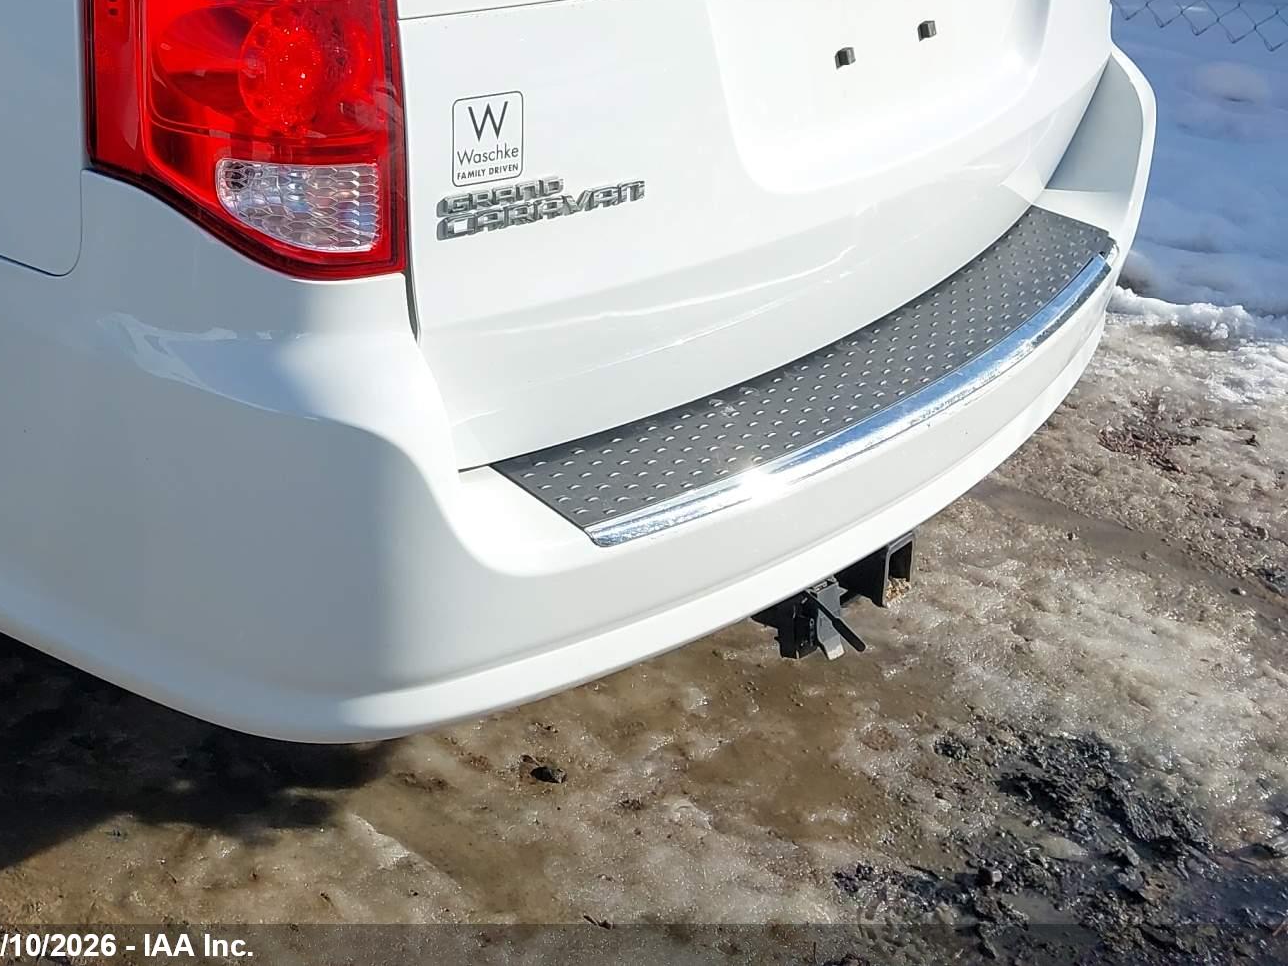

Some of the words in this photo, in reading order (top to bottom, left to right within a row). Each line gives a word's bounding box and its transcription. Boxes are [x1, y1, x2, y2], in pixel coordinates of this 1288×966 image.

[468, 101, 508, 141] W
[457, 143, 519, 165] Waschke
[457, 169, 486, 180] FAMILY
[489, 164, 519, 175] DRIVEN
[436, 178, 563, 217] GRAND
[437, 181, 645, 240] CARAVAN
